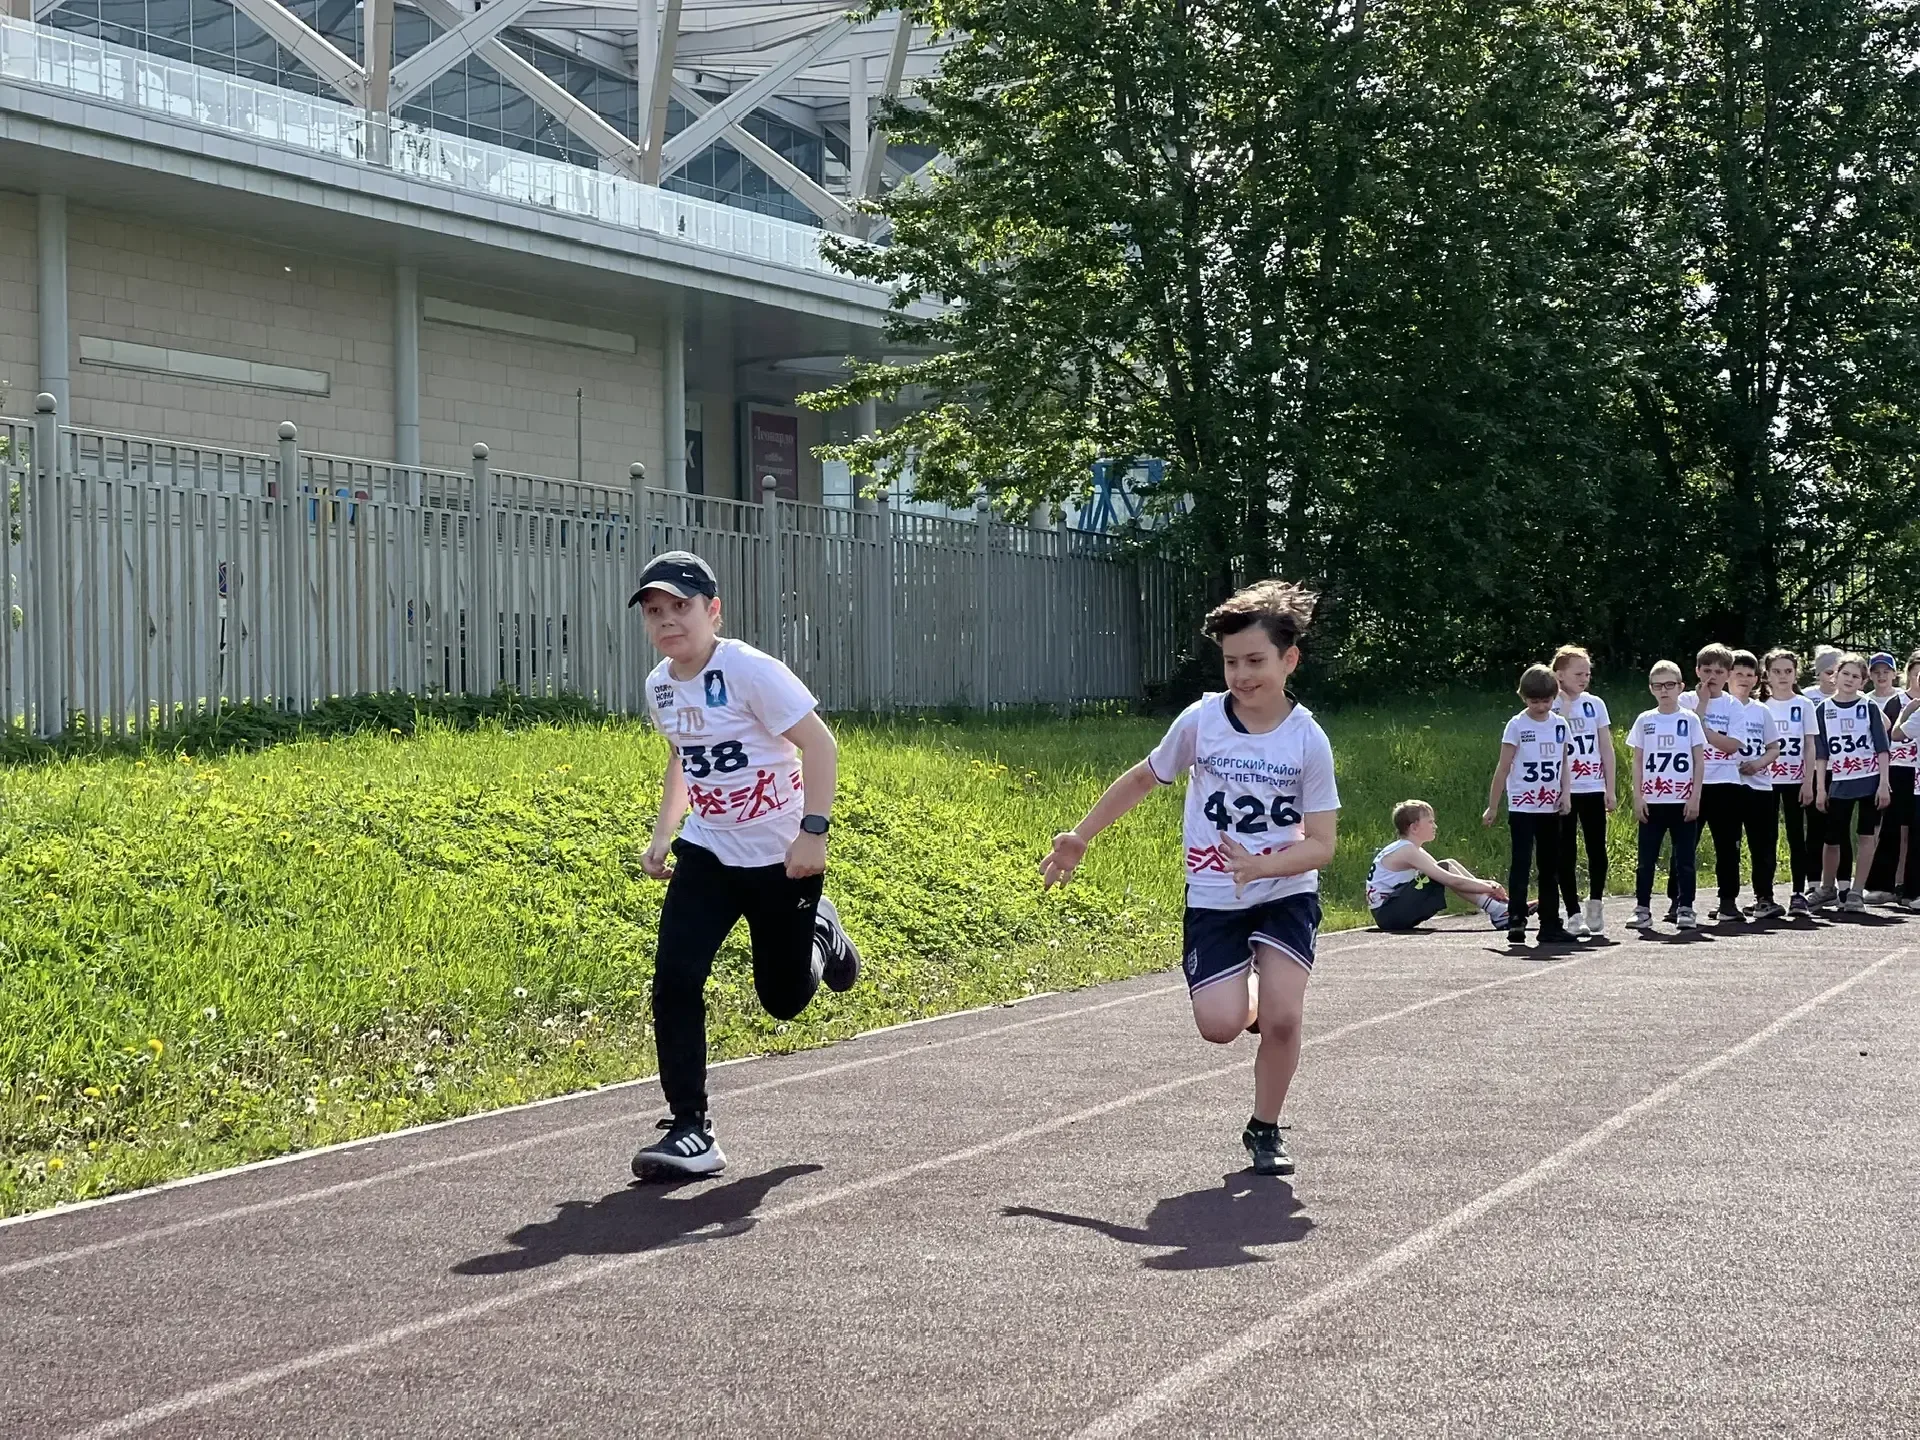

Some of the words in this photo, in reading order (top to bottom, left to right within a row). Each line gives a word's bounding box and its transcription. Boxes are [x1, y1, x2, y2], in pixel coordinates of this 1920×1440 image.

[1829, 734, 1870, 755] 634
[675, 740, 749, 778] 38
[1267, 763, 1302, 776] РАЙОН
[1645, 752, 1689, 773] 476
[1203, 790, 1302, 834] 426
